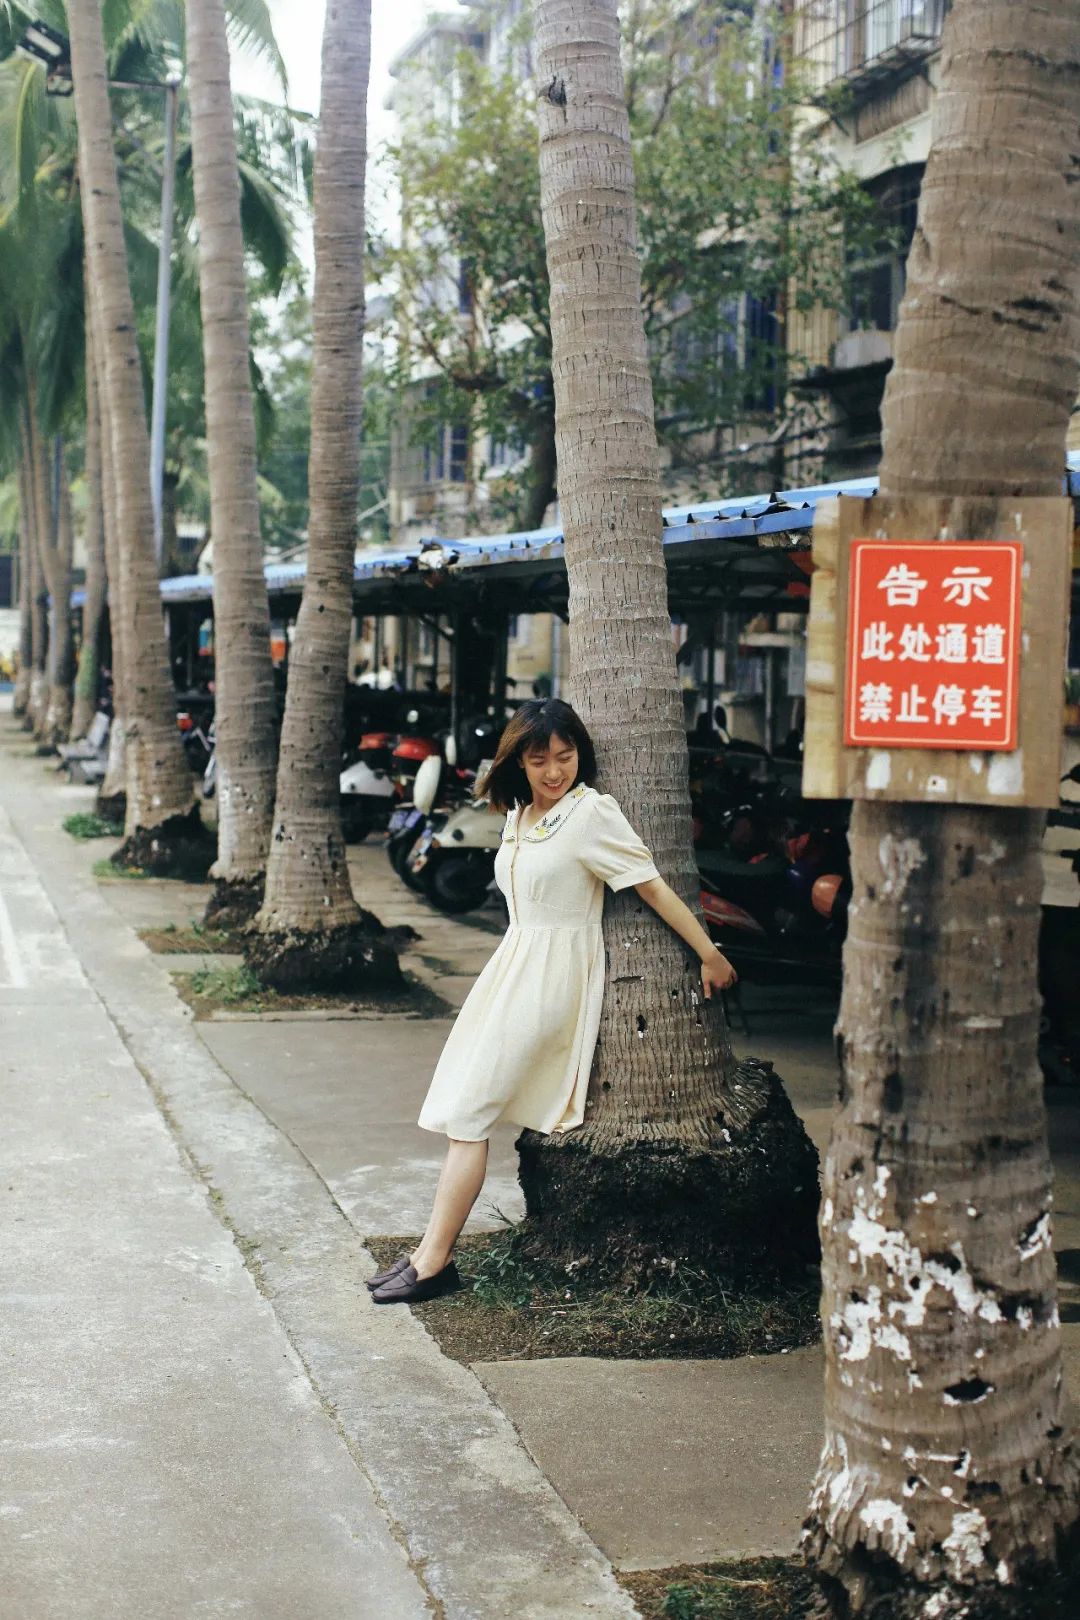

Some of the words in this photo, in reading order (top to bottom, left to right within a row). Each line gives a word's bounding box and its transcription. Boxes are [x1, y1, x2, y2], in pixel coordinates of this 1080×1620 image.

[877, 563, 993, 607] 告示
[861, 622, 1005, 664] 此处通道
[859, 682, 1003, 726] 禁止停车
